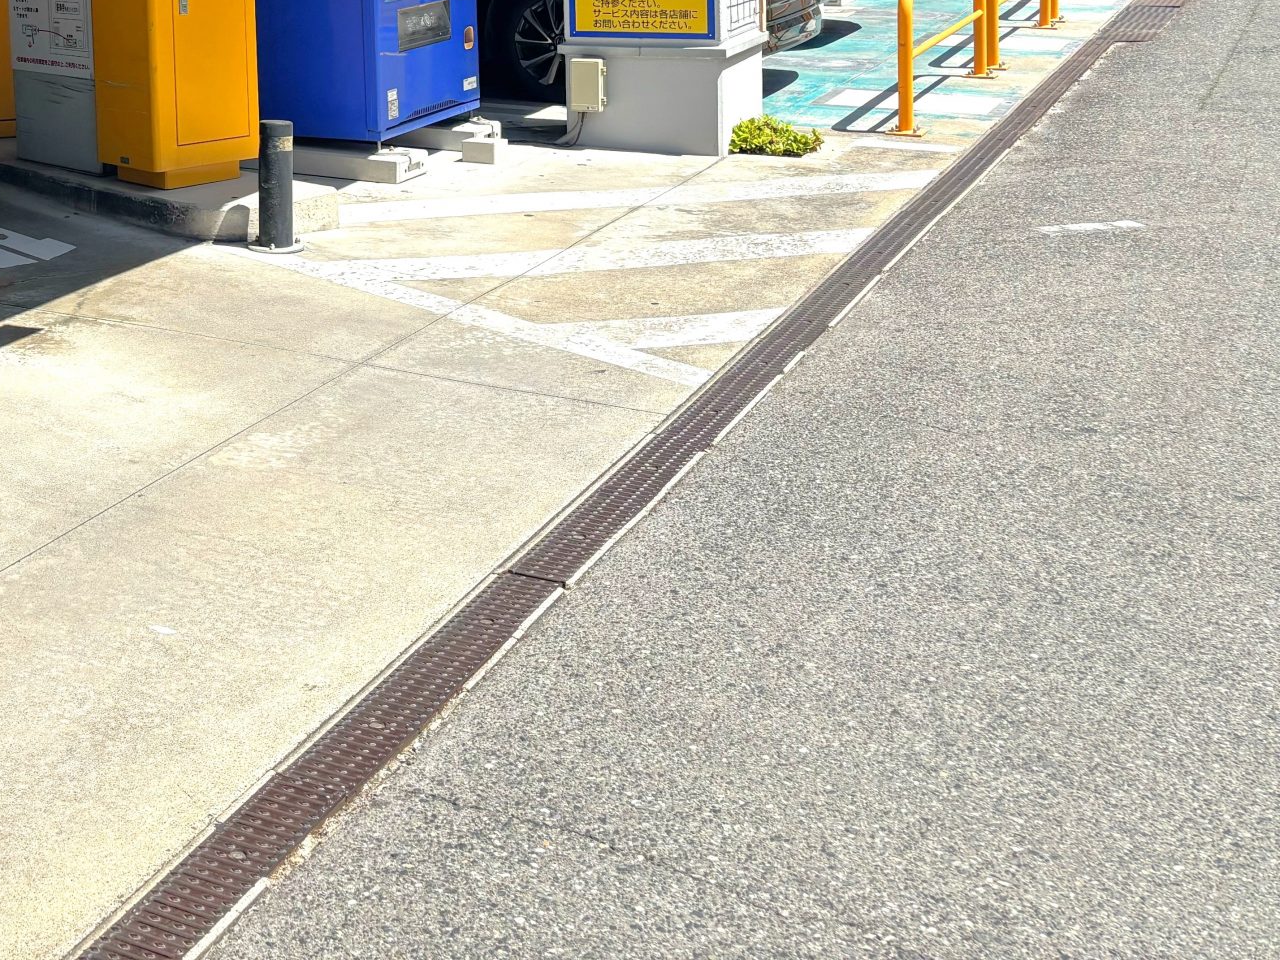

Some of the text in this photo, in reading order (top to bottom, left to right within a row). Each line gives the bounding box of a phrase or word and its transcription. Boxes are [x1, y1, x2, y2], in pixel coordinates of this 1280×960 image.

[592, 0, 662, 9] ご持参ください。
[592, 9, 699, 20] サービス内容は各店舗に
[592, 19, 693, 30] お問い合わせください。
